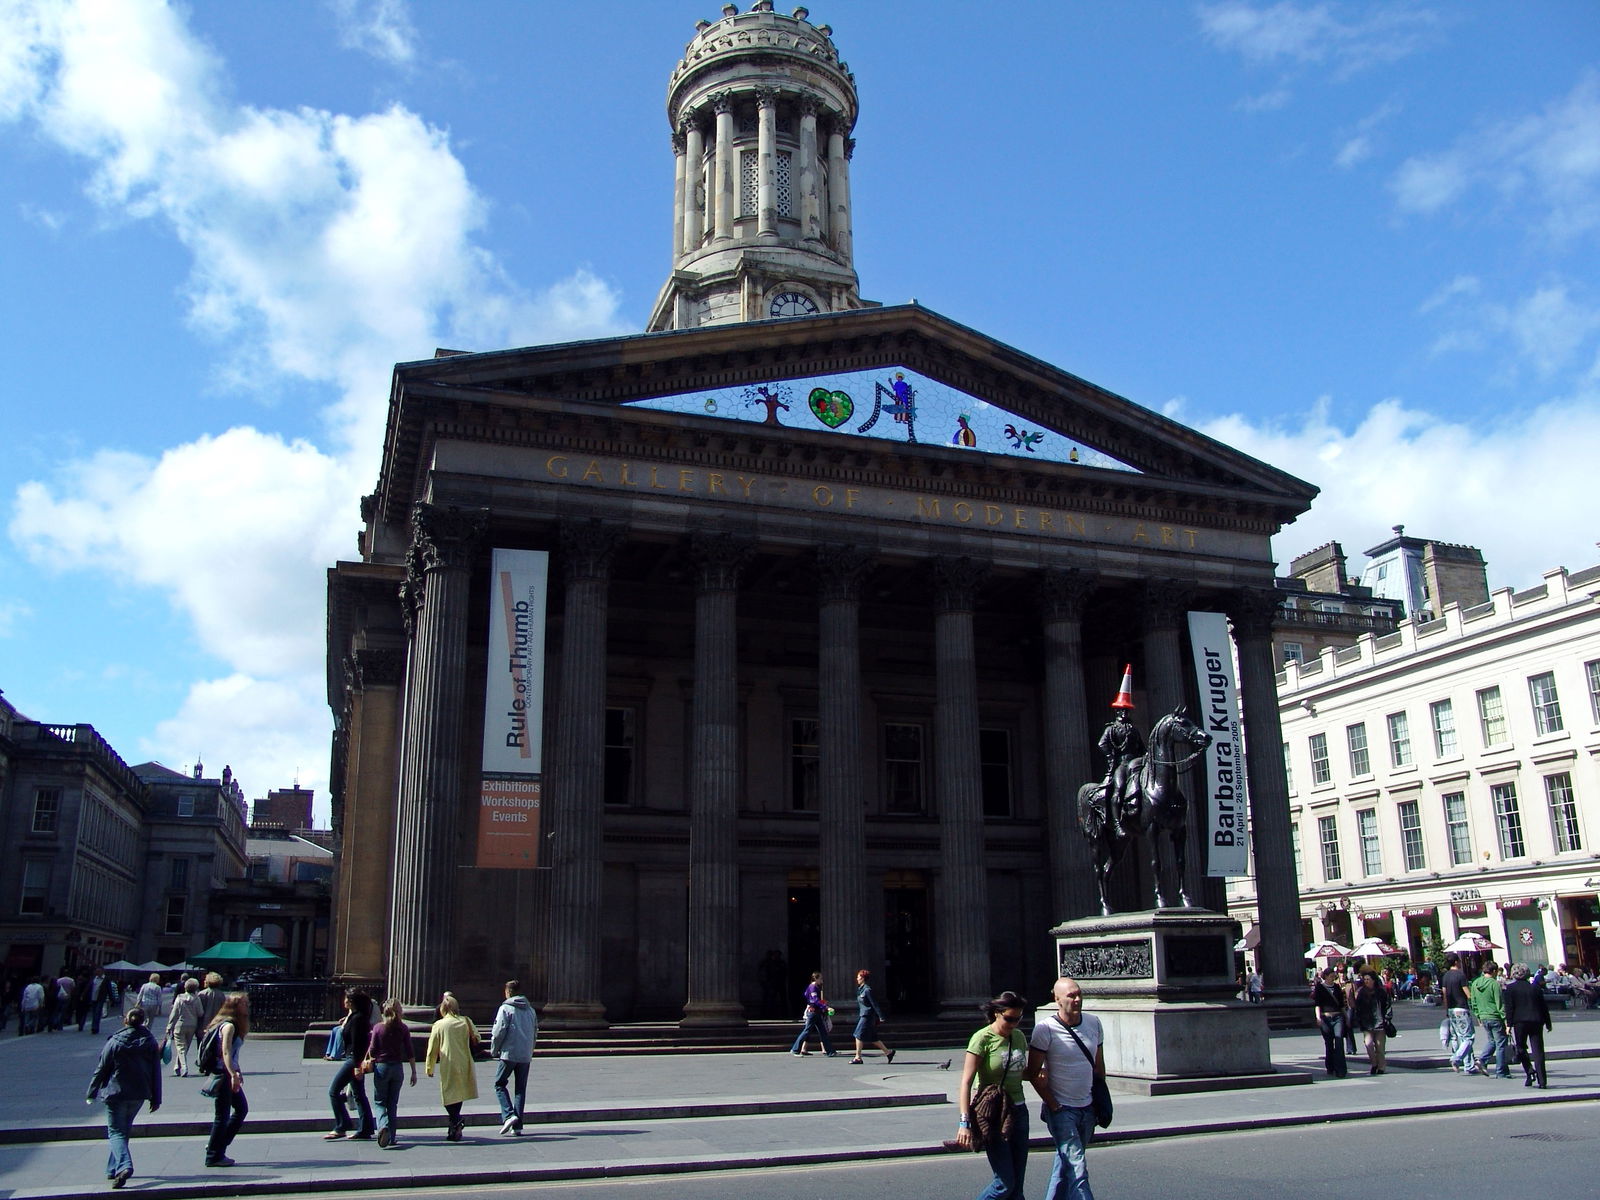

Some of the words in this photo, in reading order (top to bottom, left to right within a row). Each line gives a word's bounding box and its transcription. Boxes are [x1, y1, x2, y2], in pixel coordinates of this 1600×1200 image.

[546, 455, 757, 497] GALLERY
[812, 485, 860, 508] OF
[916, 497, 1086, 537] MODERN
[1133, 523, 1200, 549] ART
[510, 601, 528, 672] Thumb
[513, 677, 526, 693] of
[1204, 646, 1230, 732] Kruger
[506, 699, 526, 748] Rule
[1233, 744, 1243, 790] September
[482, 780, 540, 792] Exhibitions
[1214, 742, 1234, 846] Barbara
[481, 796, 540, 809] Workshops
[1236, 792, 1242, 803] 26
[492, 811, 528, 822] Events
[1236, 812, 1245, 834] April
[1236, 836, 1244, 847] 21
[1450, 888, 1481, 900] COSTA
